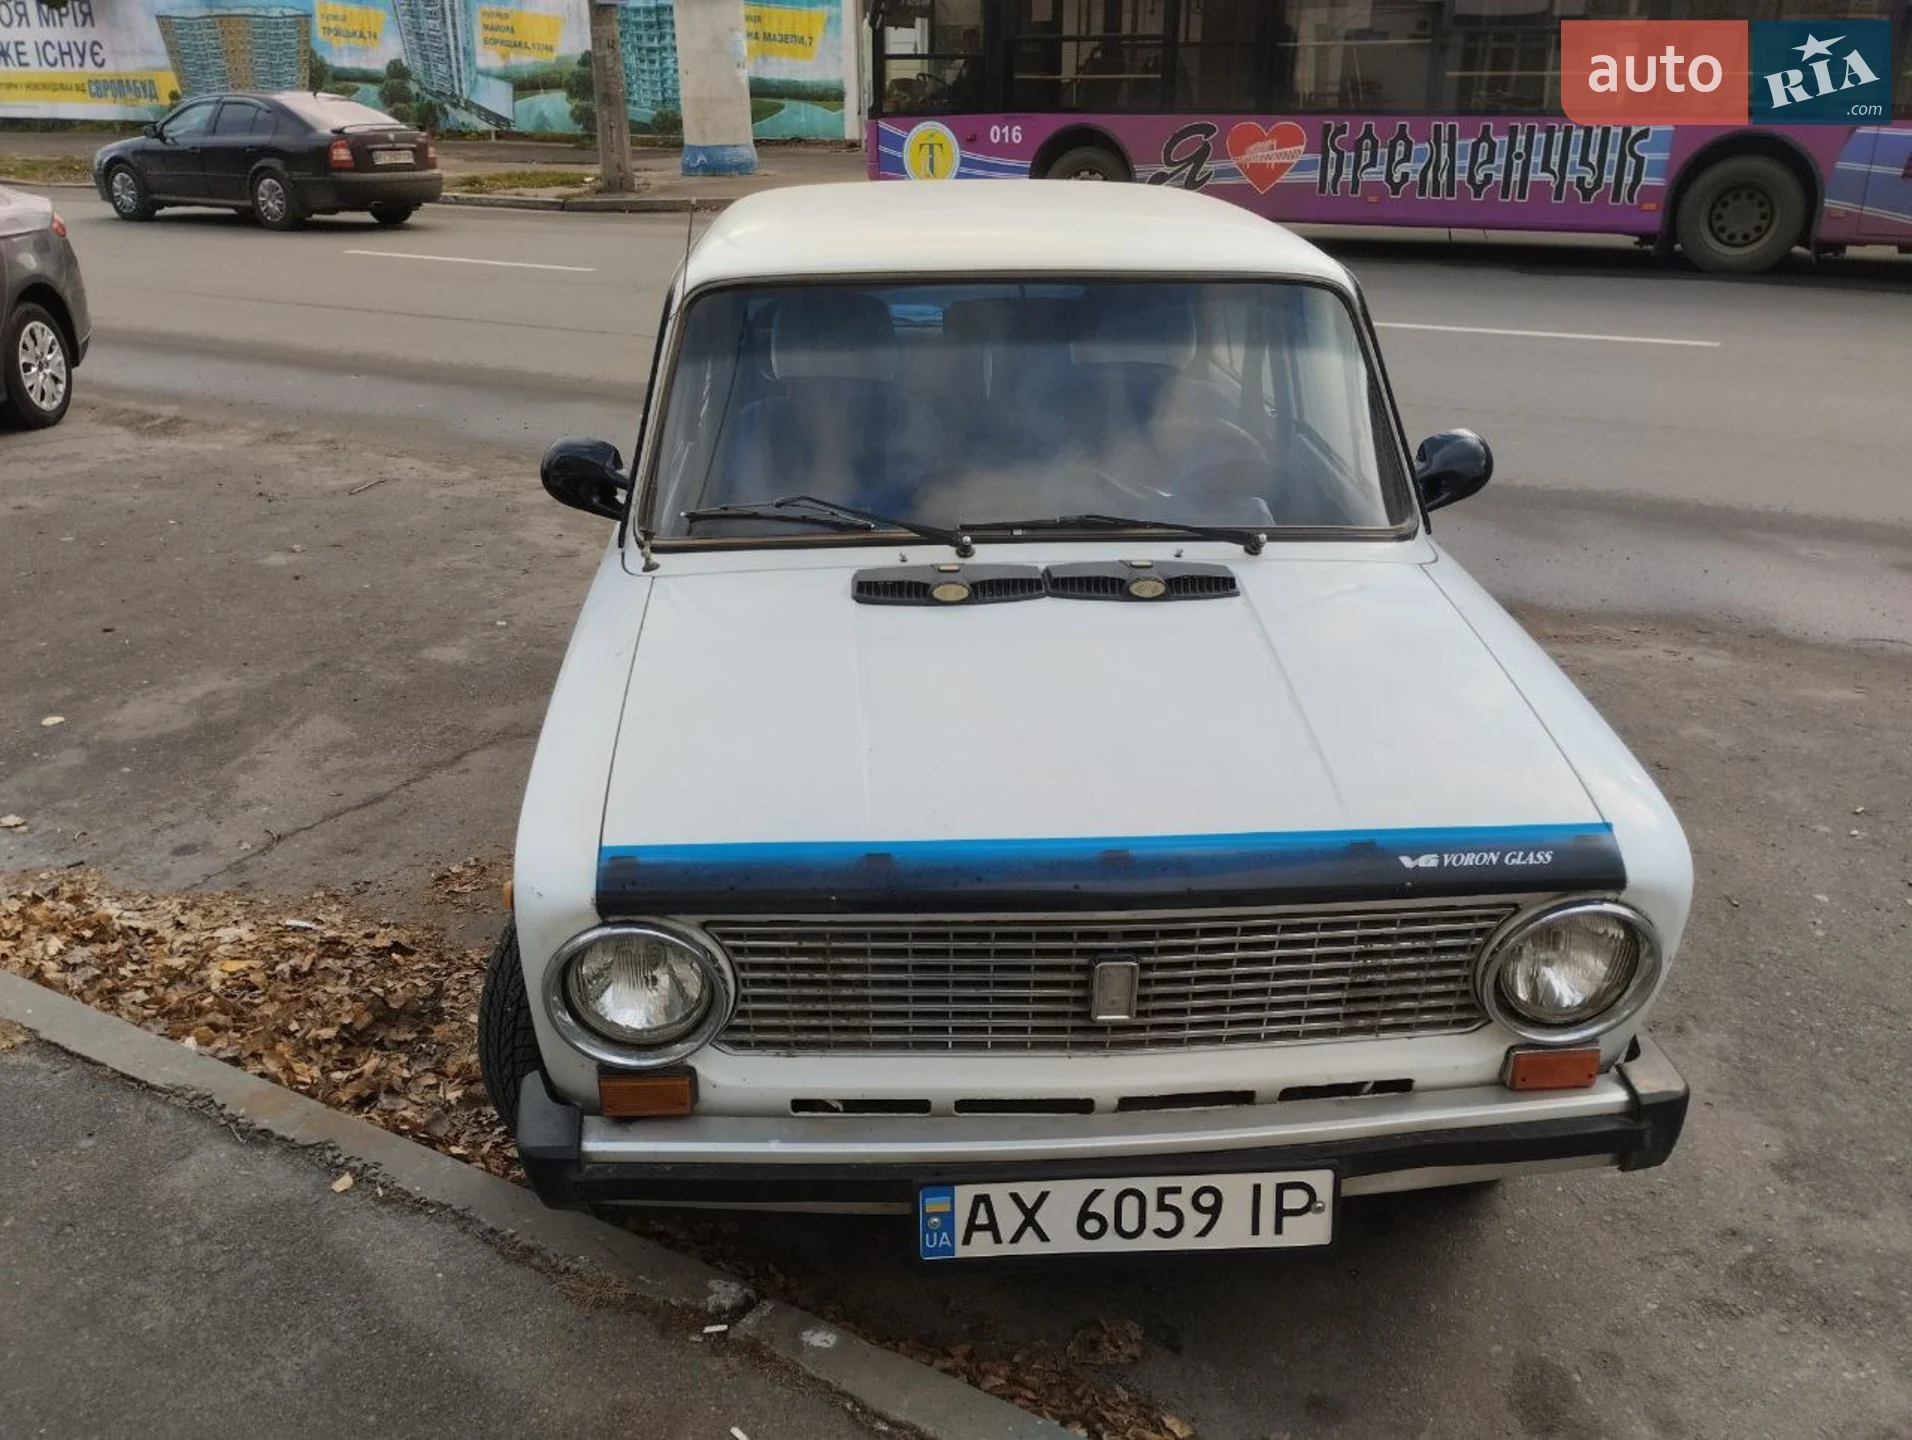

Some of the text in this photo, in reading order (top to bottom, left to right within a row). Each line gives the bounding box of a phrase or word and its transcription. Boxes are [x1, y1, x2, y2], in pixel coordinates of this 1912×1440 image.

[36, 0, 95, 28] МРІЯ
[34, 40, 106, 68] ІСНУЄ
[989, 125, 1023, 144] 016
[1443, 852, 1499, 868] VORON
[1504, 850, 1553, 866] GLASS
[961, 1181, 1319, 1247] AX 6059 IP
[925, 1231, 952, 1248] UA
